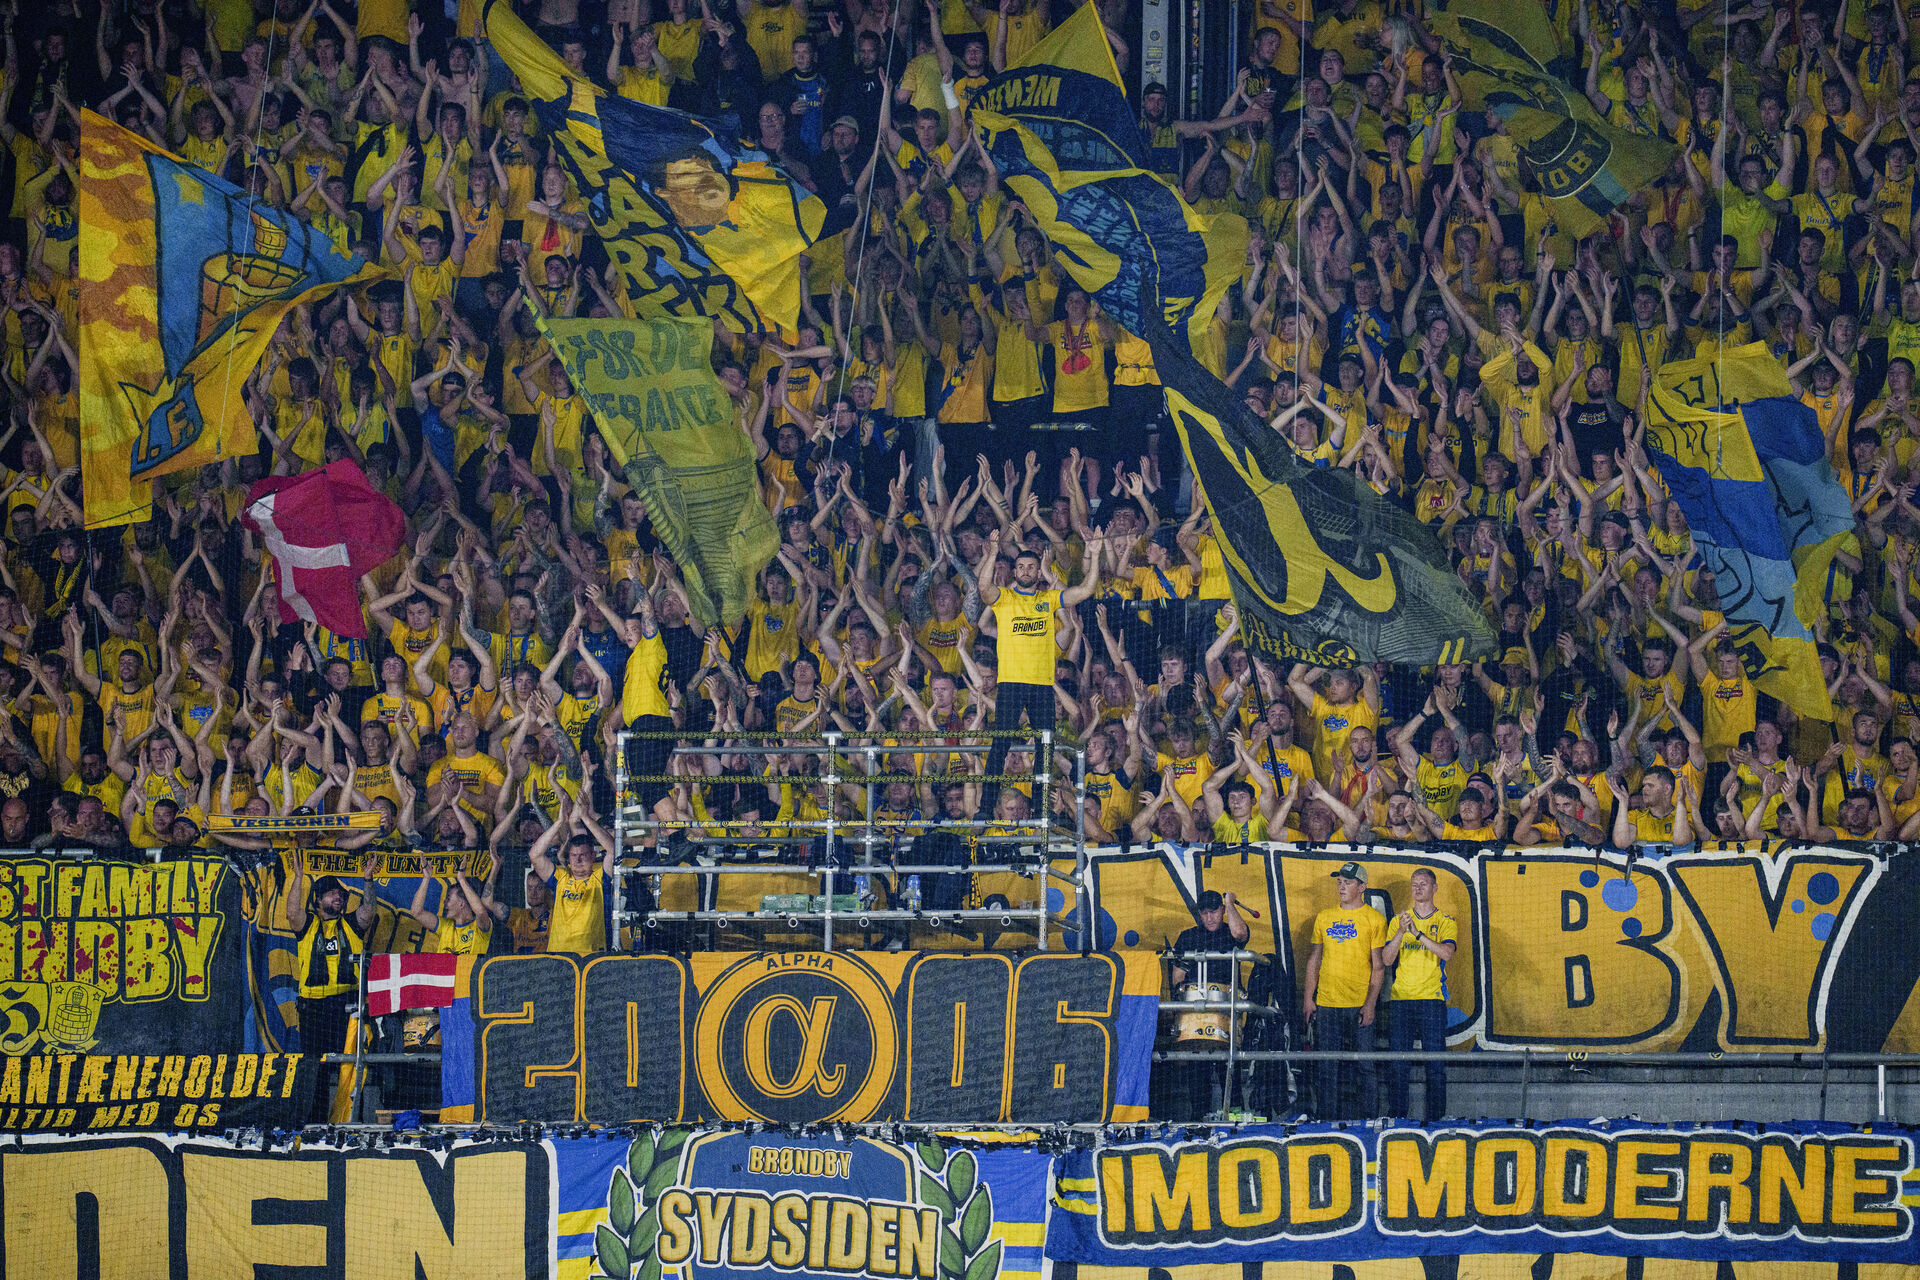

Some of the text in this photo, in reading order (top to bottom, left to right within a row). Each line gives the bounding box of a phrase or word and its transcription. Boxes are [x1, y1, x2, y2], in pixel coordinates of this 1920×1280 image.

[231, 815, 350, 828] VESTEGNEN
[306, 854, 359, 872] THE
[57, 861, 222, 917] FAMILY
[766, 953, 833, 972] ALPHA
[0, 1101, 222, 1129] LTID MED OS
[750, 1147, 850, 1178] BRØNDBY
[1104, 1138, 1899, 1232] IMOD MODERNE
[659, 1190, 937, 1277] SYDSIDEN
